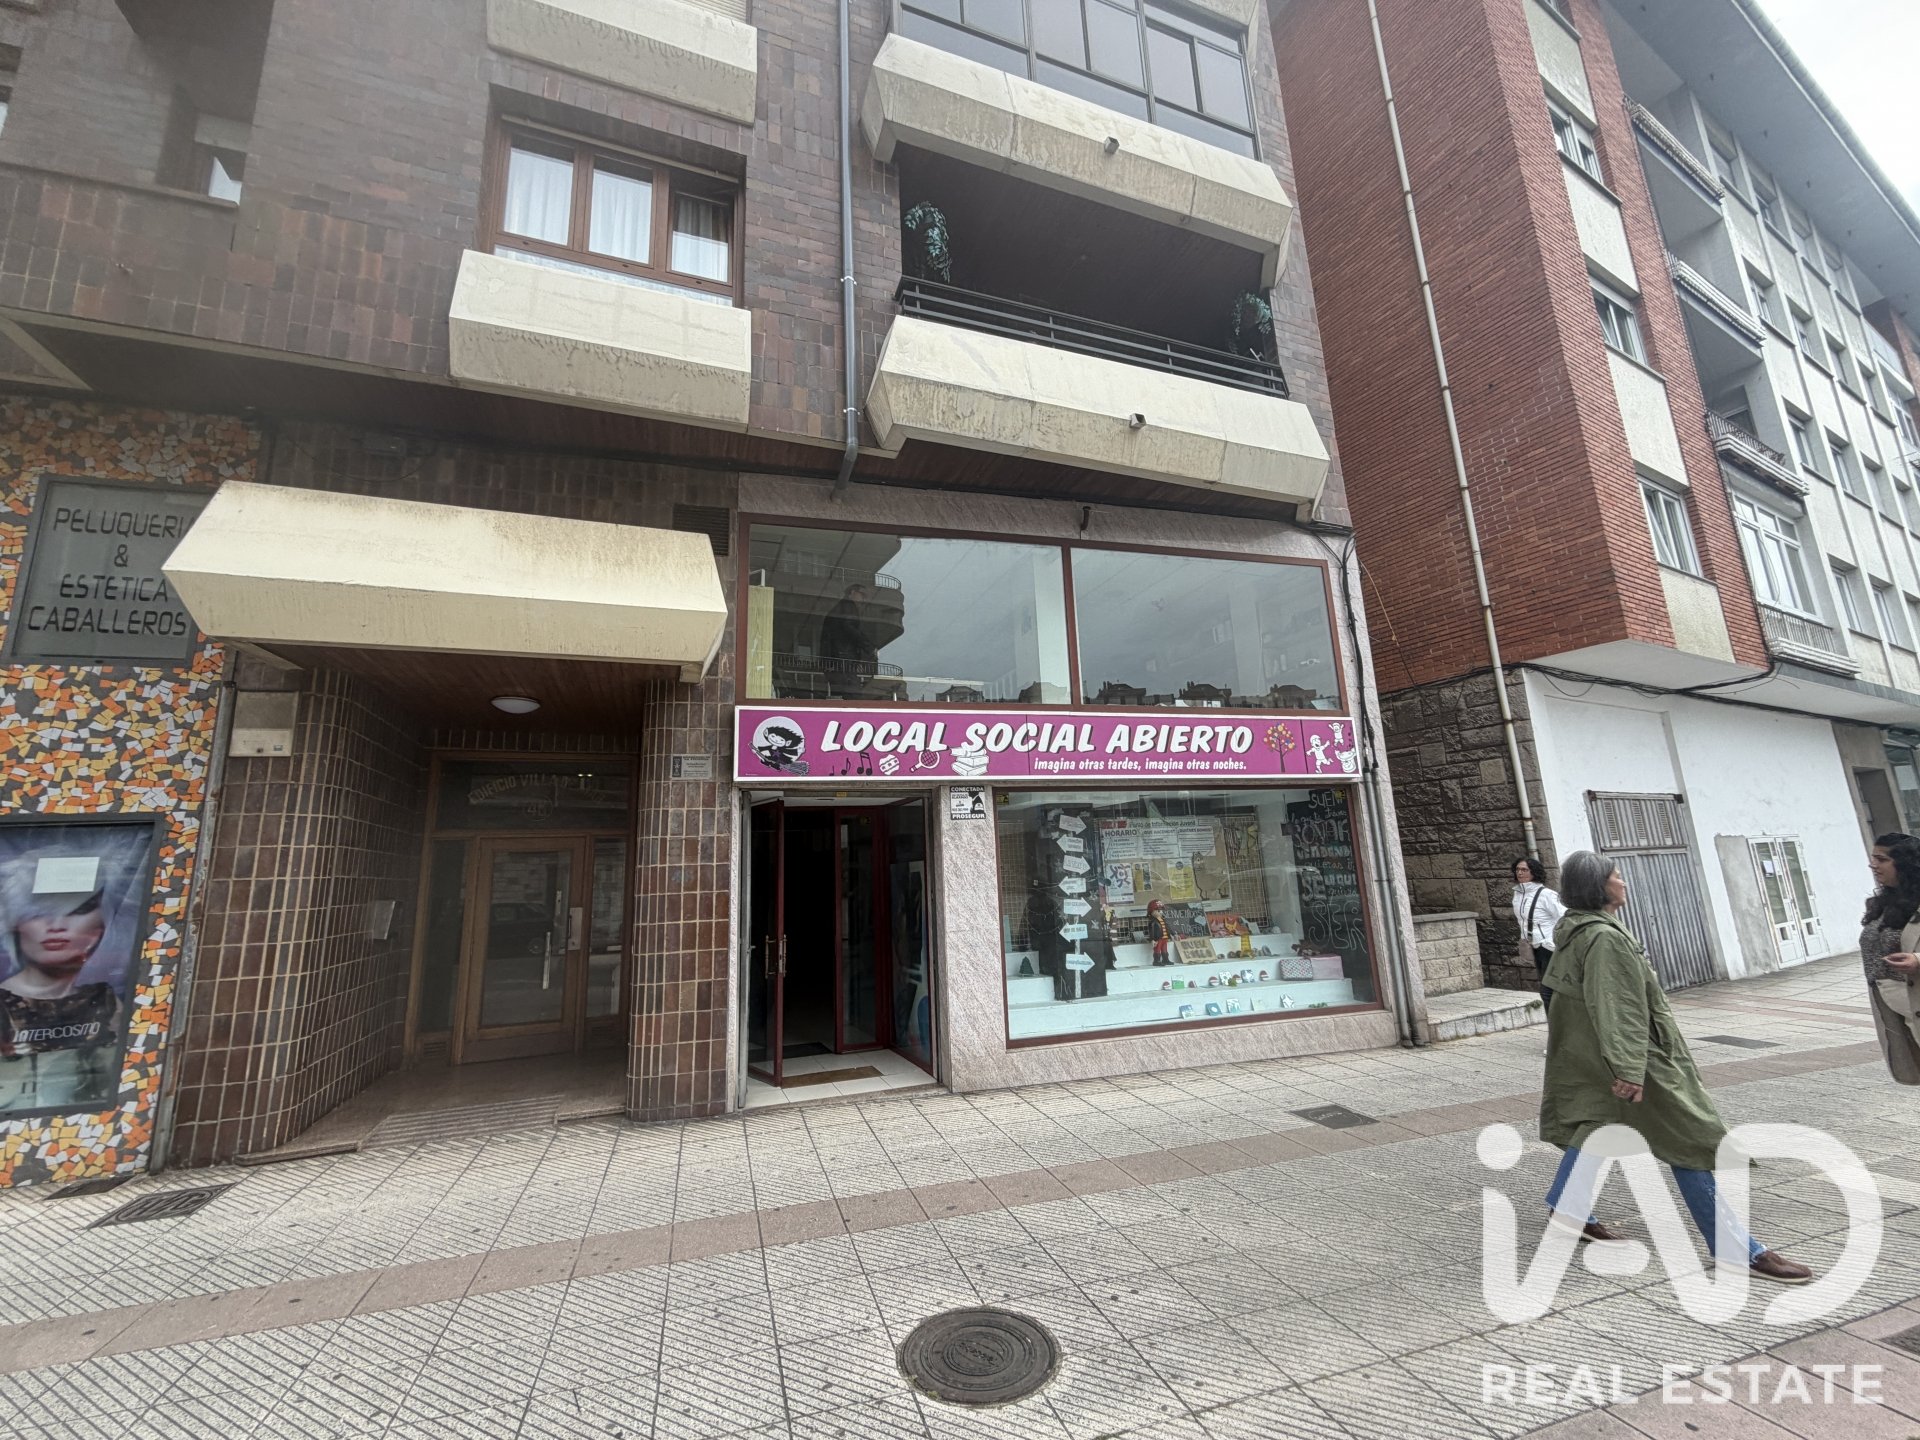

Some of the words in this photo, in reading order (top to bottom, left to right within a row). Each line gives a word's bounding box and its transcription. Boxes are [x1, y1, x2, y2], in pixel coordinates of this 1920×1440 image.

[113, 543, 129, 568] &
[59, 573, 168, 602] ESTETICA
[27, 606, 187, 636] CABALLEROS
[820, 720, 950, 753] LOCAL
[961, 721, 1095, 754] SOCIAL
[1105, 723, 1254, 754] ABIERTO
[1033, 757, 1076, 774] imagina
[1079, 757, 1105, 771] otras
[1108, 757, 1142, 771] tardes,
[1145, 758, 1184, 773] imagina
[1186, 758, 1211, 771] otras
[1213, 758, 1247, 771] noches.
[467, 776, 517, 804] EDIFICIO
[1104, 829, 1138, 838] HORARIO
[1308, 900, 1368, 954] SER
[12, 1022, 101, 1043] INTERCOSMO
